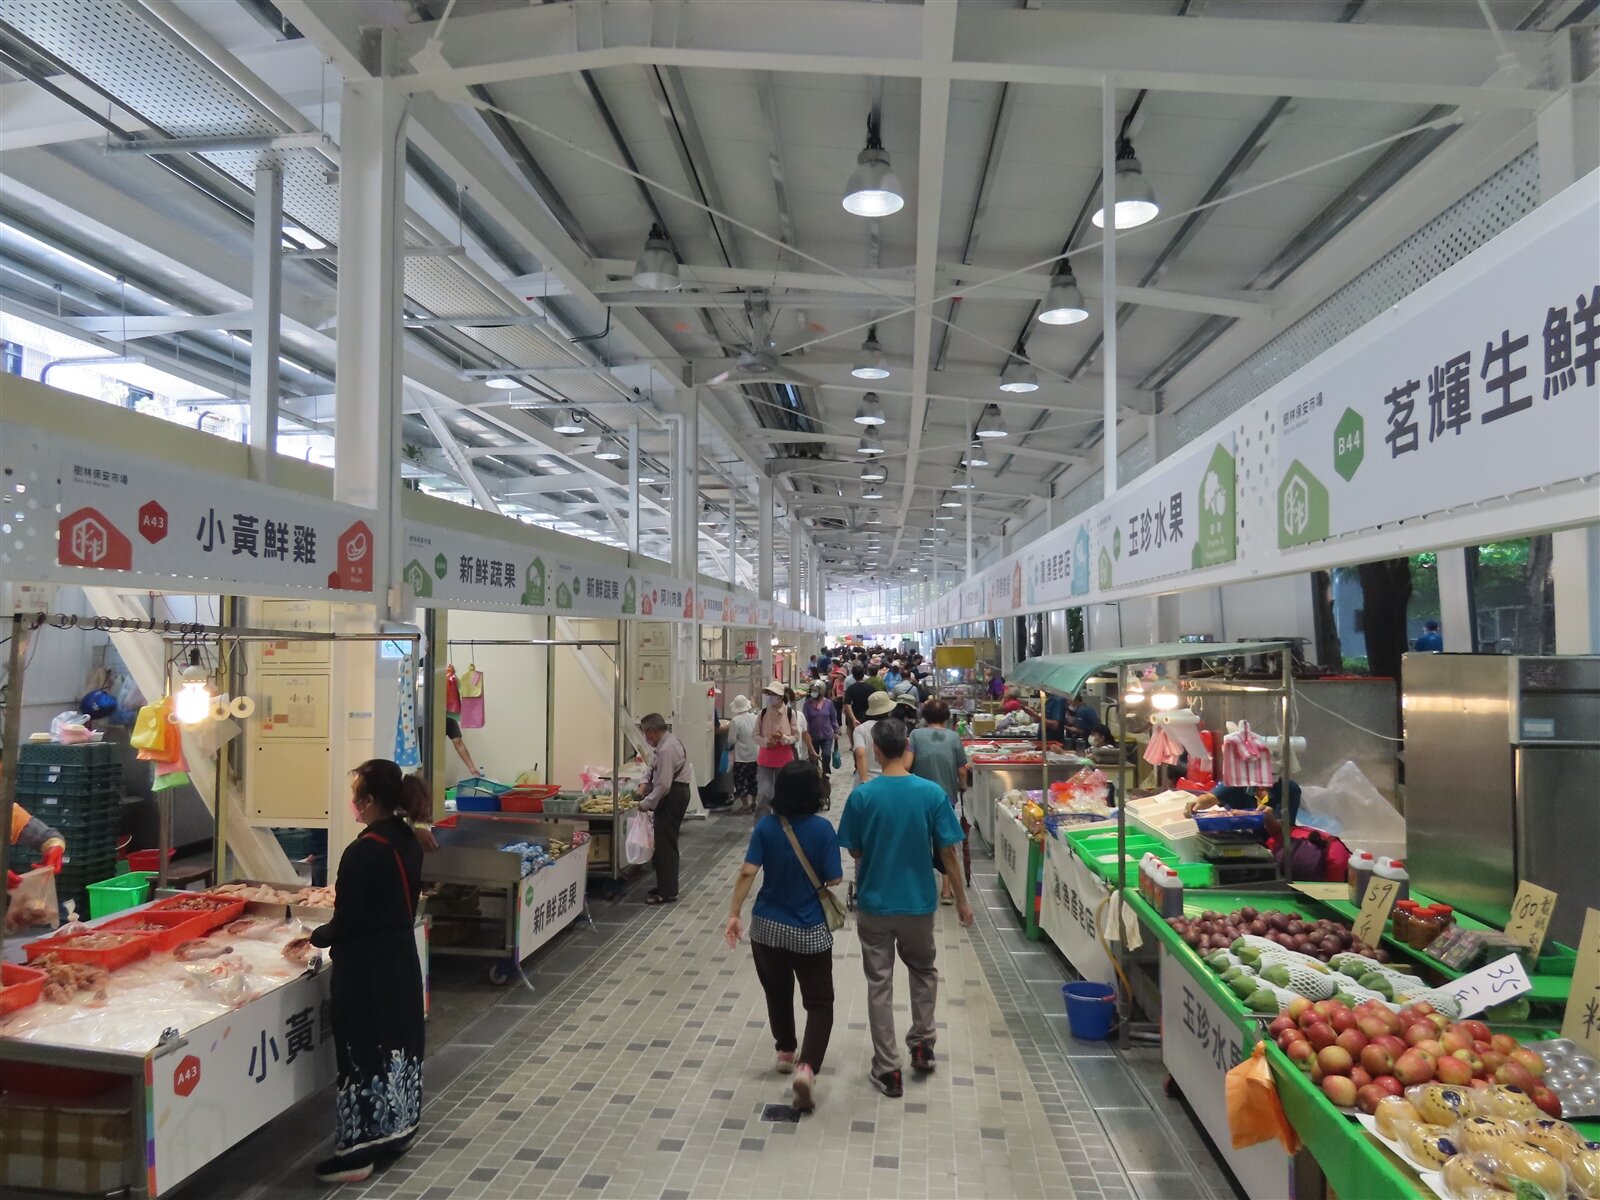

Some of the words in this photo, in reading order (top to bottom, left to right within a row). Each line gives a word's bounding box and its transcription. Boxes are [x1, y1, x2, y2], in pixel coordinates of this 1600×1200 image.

[1384, 285, 1600, 459] 茗輝生鮮
[1338, 430, 1360, 455] B44
[73, 464, 128, 485] 樹林保安市場
[143, 515, 164, 528] A43
[1129, 491, 1184, 557] 玉珍水果
[196, 508, 316, 564] 小黃鮮雞
[459, 554, 516, 589] 新鮮蔬果
[533, 881, 577, 935] 新鮮蔬果
[1369, 883, 1393, 910] 59
[1514, 894, 1538, 920] 180
[1487, 964, 1521, 994] 35
[176, 1065, 198, 1086] A43
